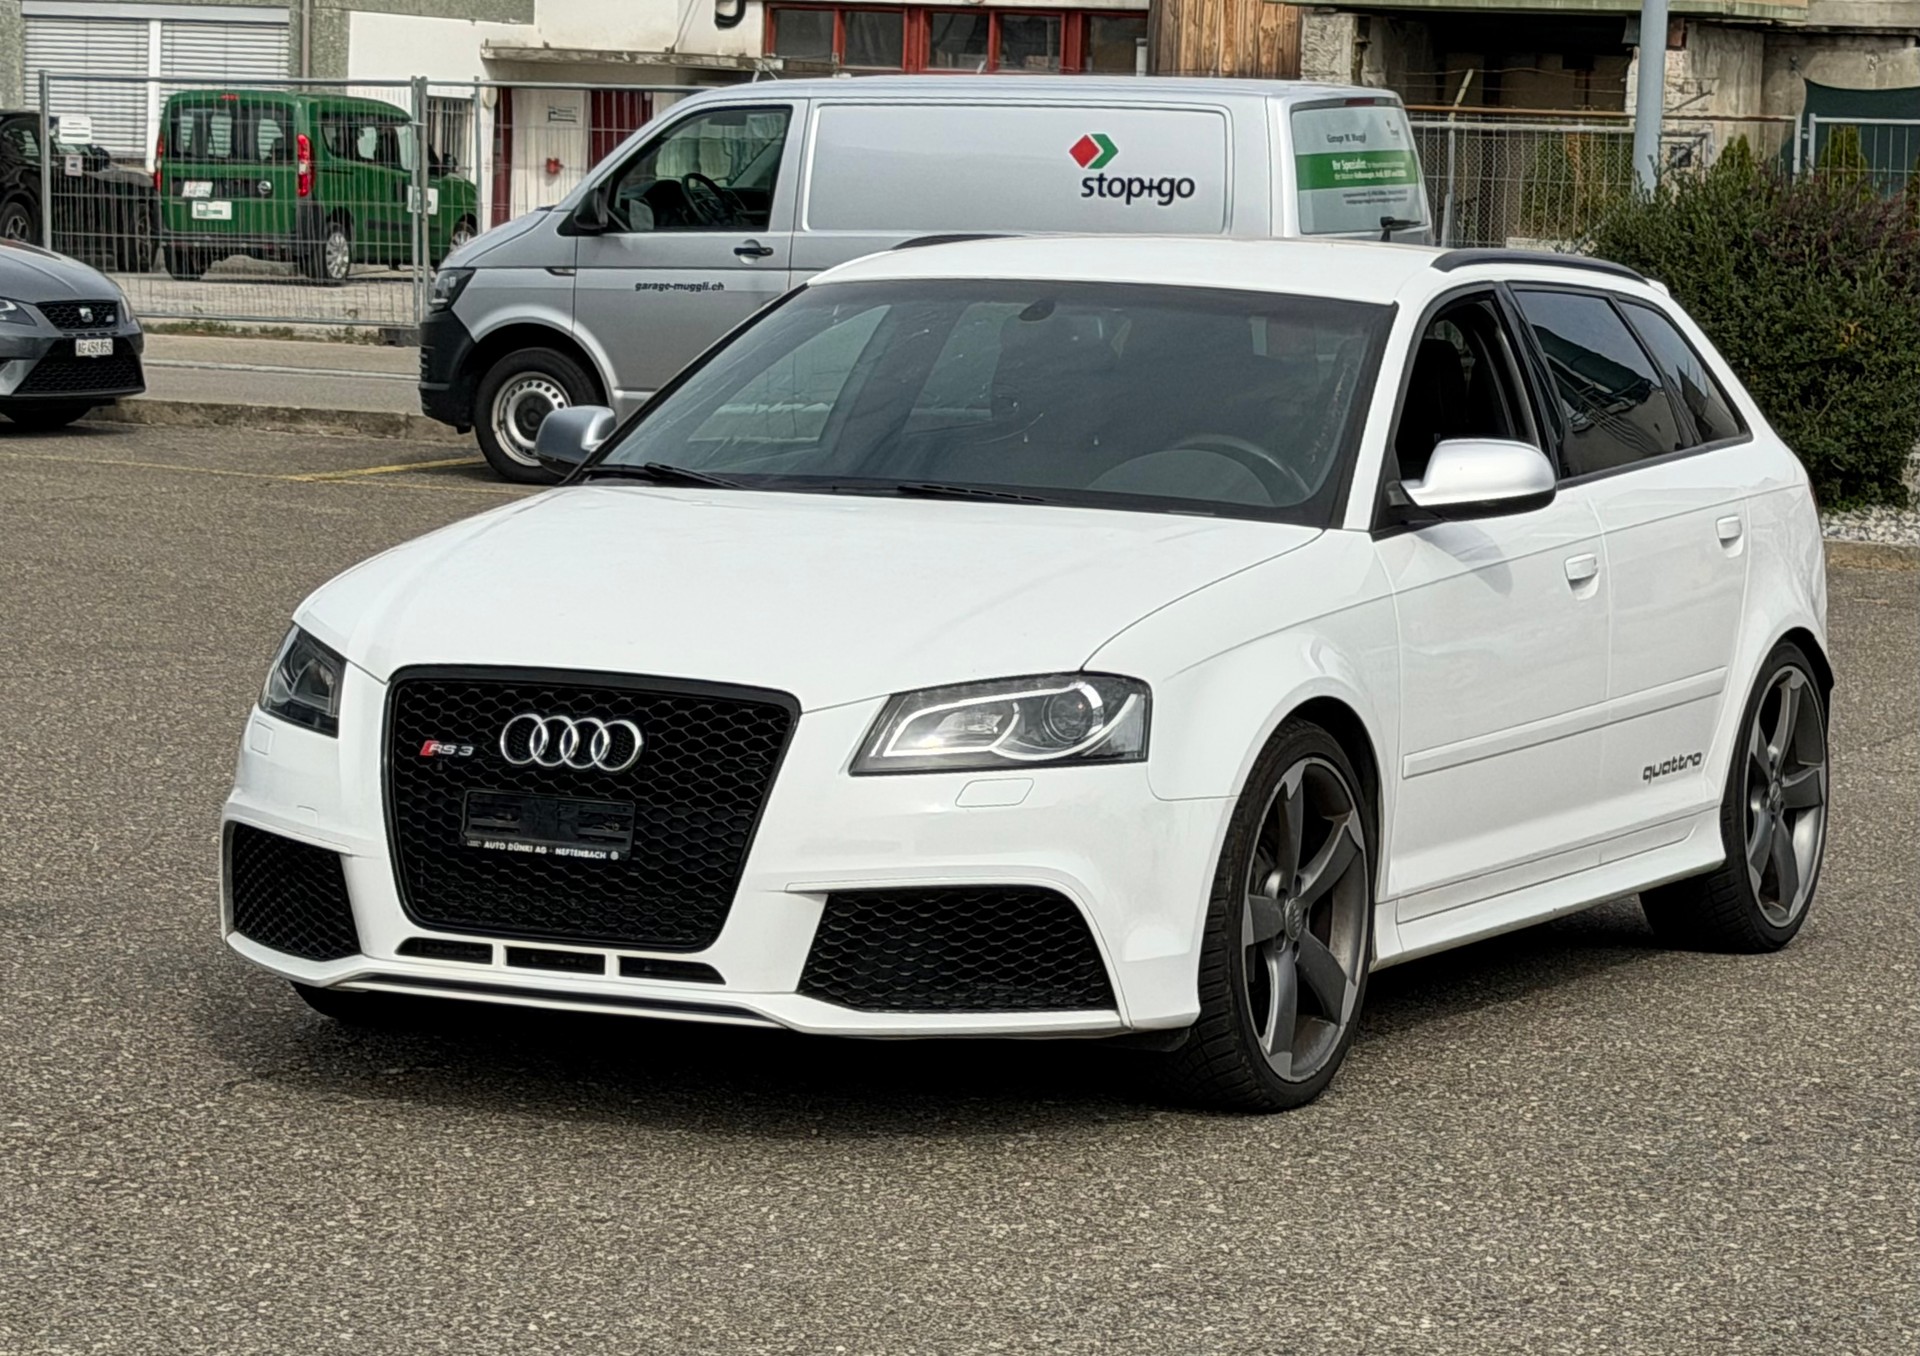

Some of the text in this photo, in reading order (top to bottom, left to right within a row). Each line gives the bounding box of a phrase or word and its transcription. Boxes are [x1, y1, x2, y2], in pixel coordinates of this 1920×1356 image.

[1081, 173, 1195, 206] stop+go
[635, 282, 725, 292] garage-muggli.ch
[1643, 751, 1702, 784] quattro
[483, 840, 607, 860] AUTO DÜNKI AG NEFTENBACH
